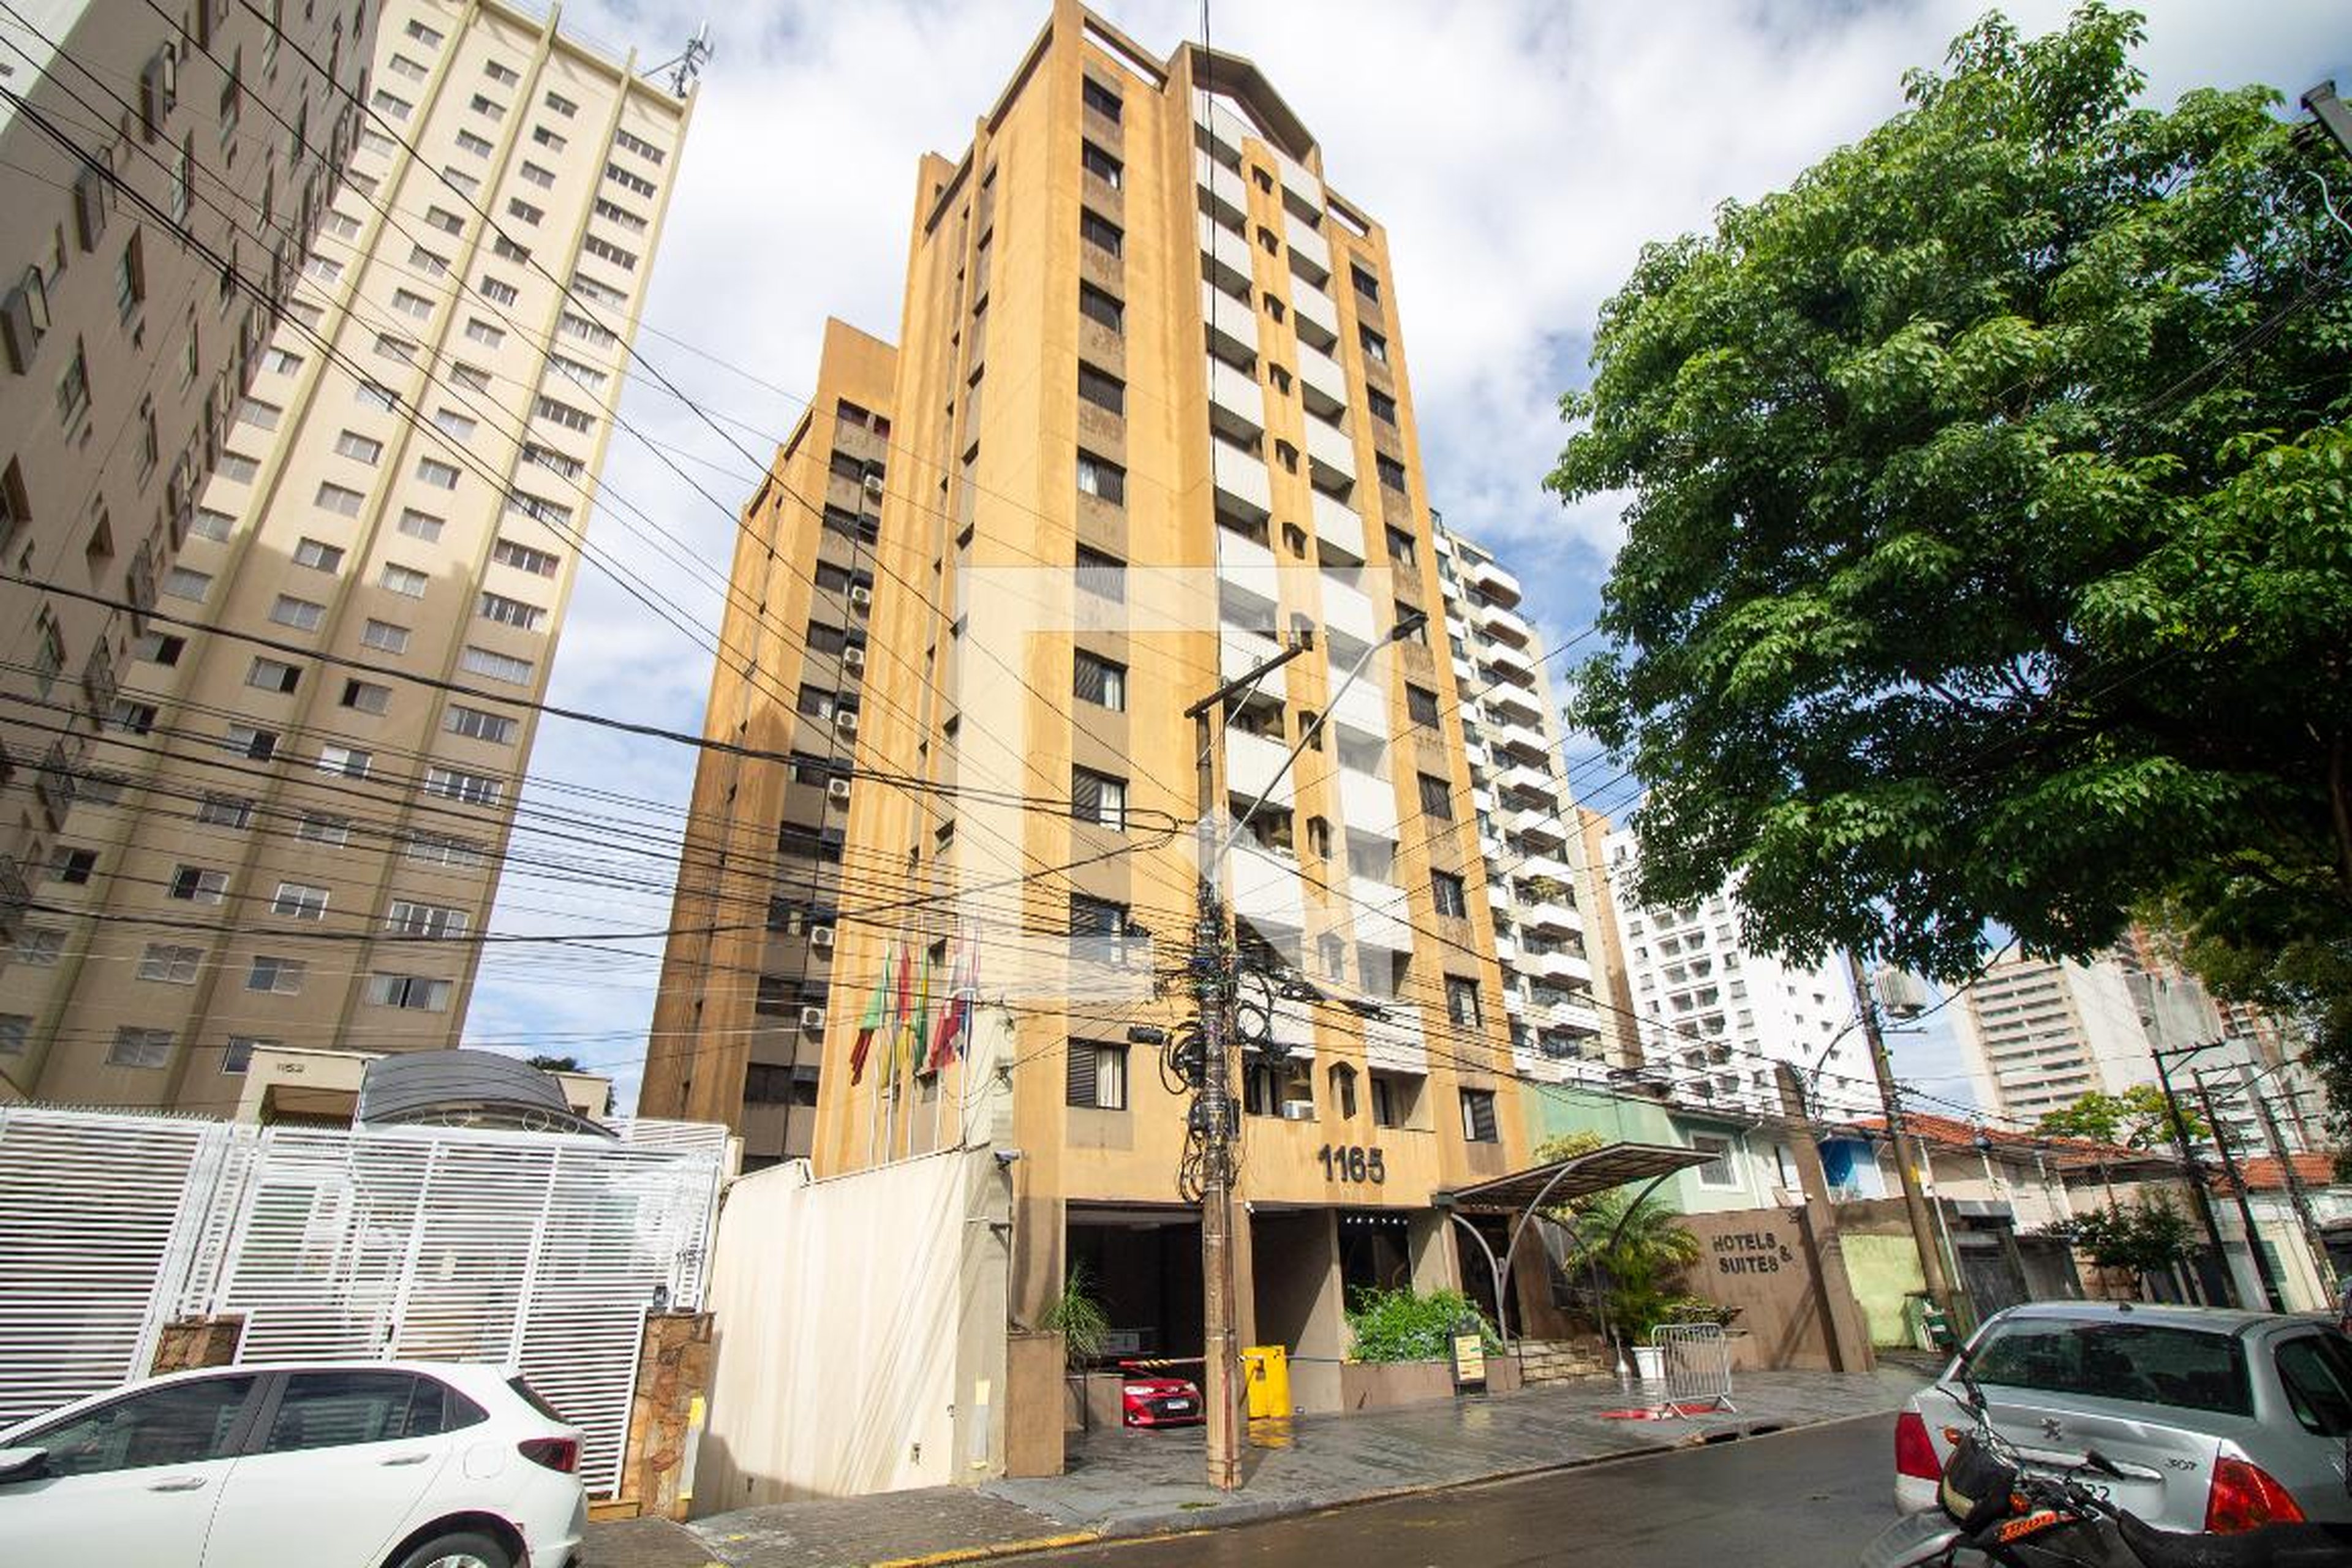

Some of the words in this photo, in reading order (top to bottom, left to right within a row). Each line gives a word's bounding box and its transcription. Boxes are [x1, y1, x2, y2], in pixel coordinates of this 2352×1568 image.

[1318, 1144, 1385, 1184] 1165
[1713, 1233, 1776, 1253] HOTELS
[1779, 1245, 1793, 1262] &
[1719, 1256, 1779, 1274] SUITES
